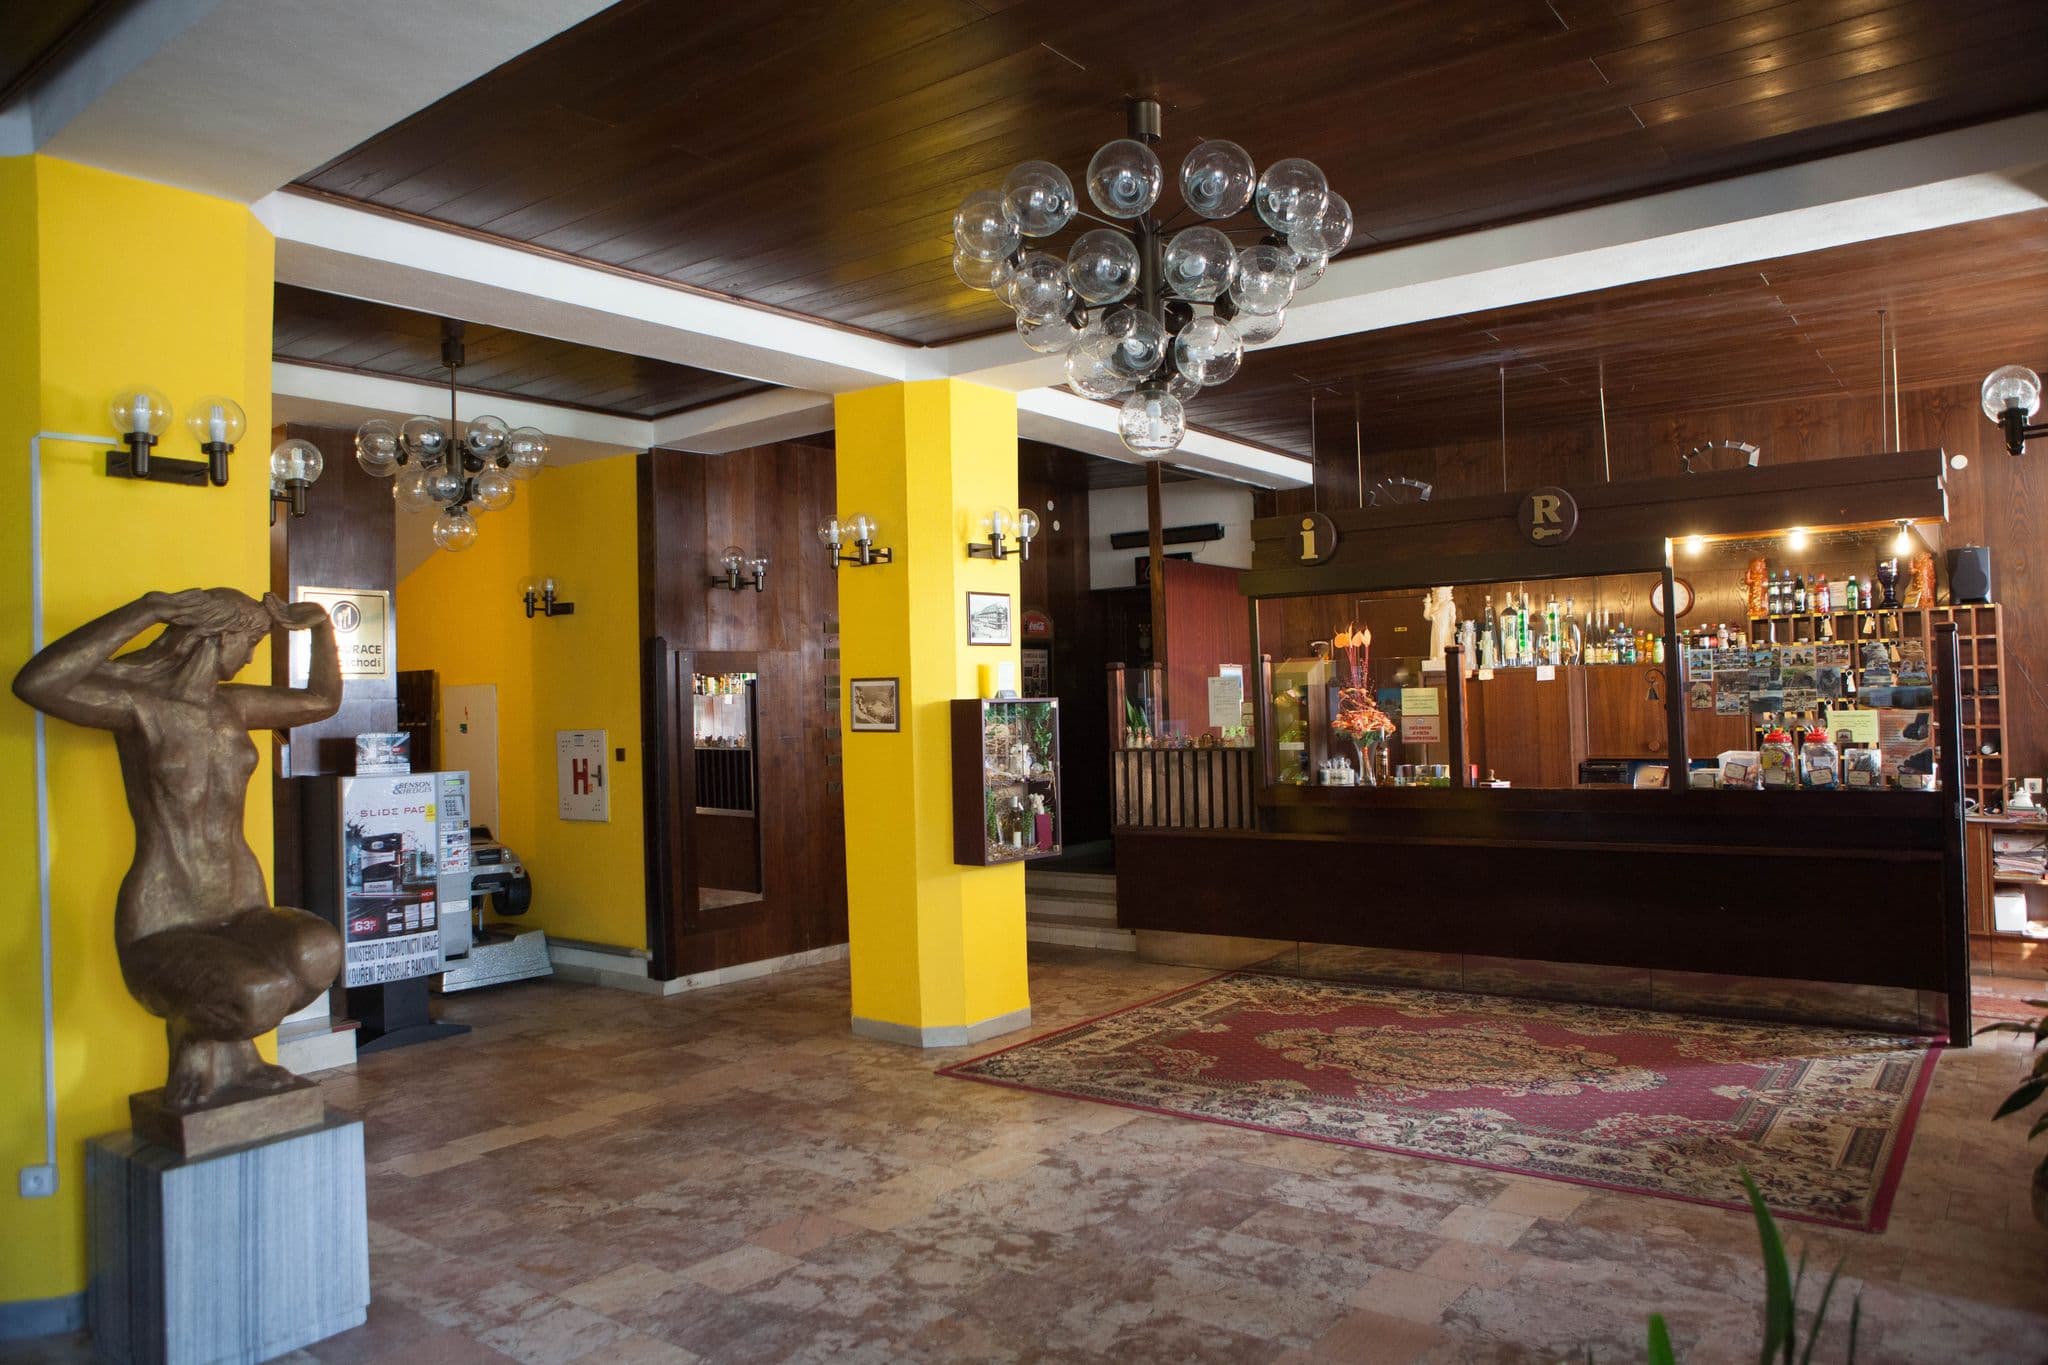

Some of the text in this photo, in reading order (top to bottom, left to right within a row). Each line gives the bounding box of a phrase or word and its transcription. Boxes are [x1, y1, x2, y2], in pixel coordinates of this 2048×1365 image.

[1531, 495, 1563, 524] R
[1300, 518, 1318, 560] i
[349, 645, 382, 654] RACE
[572, 758, 589, 795] H
[360, 808, 399, 818] SLIDE
[403, 806, 428, 815] PAC
